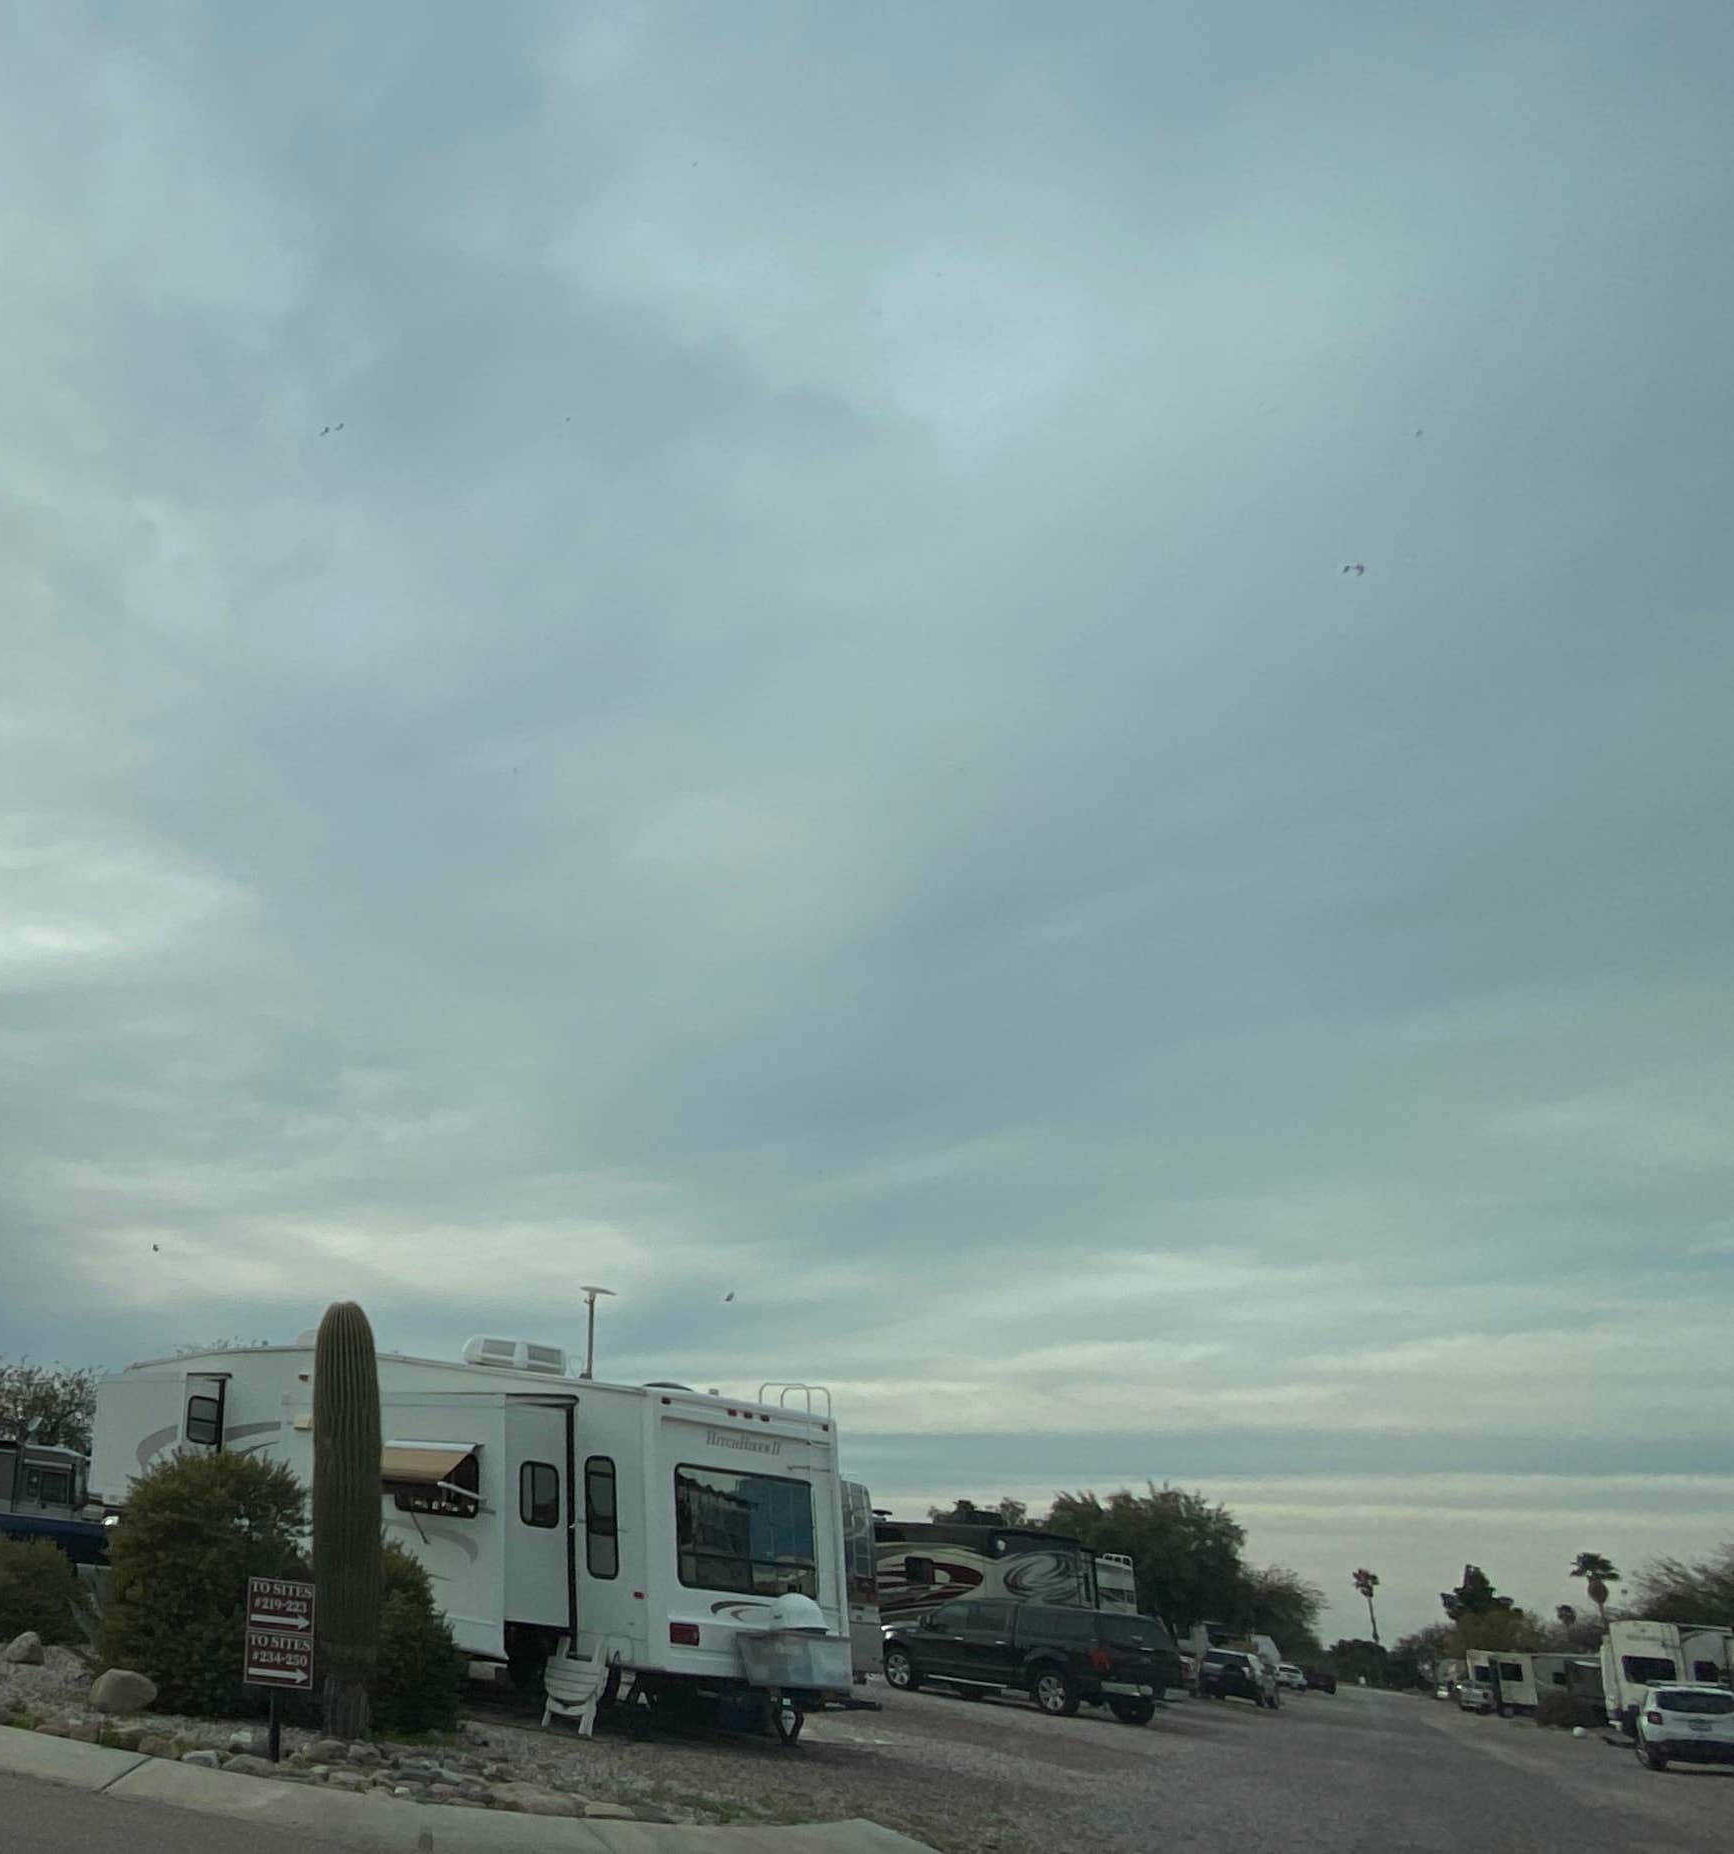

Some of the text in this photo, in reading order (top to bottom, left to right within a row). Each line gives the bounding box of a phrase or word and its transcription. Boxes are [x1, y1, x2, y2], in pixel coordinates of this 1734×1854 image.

[252, 1581, 312, 1599] TO SITES
[250, 1634, 311, 1651] TO SITES
[252, 1651, 307, 1667] #234-250
